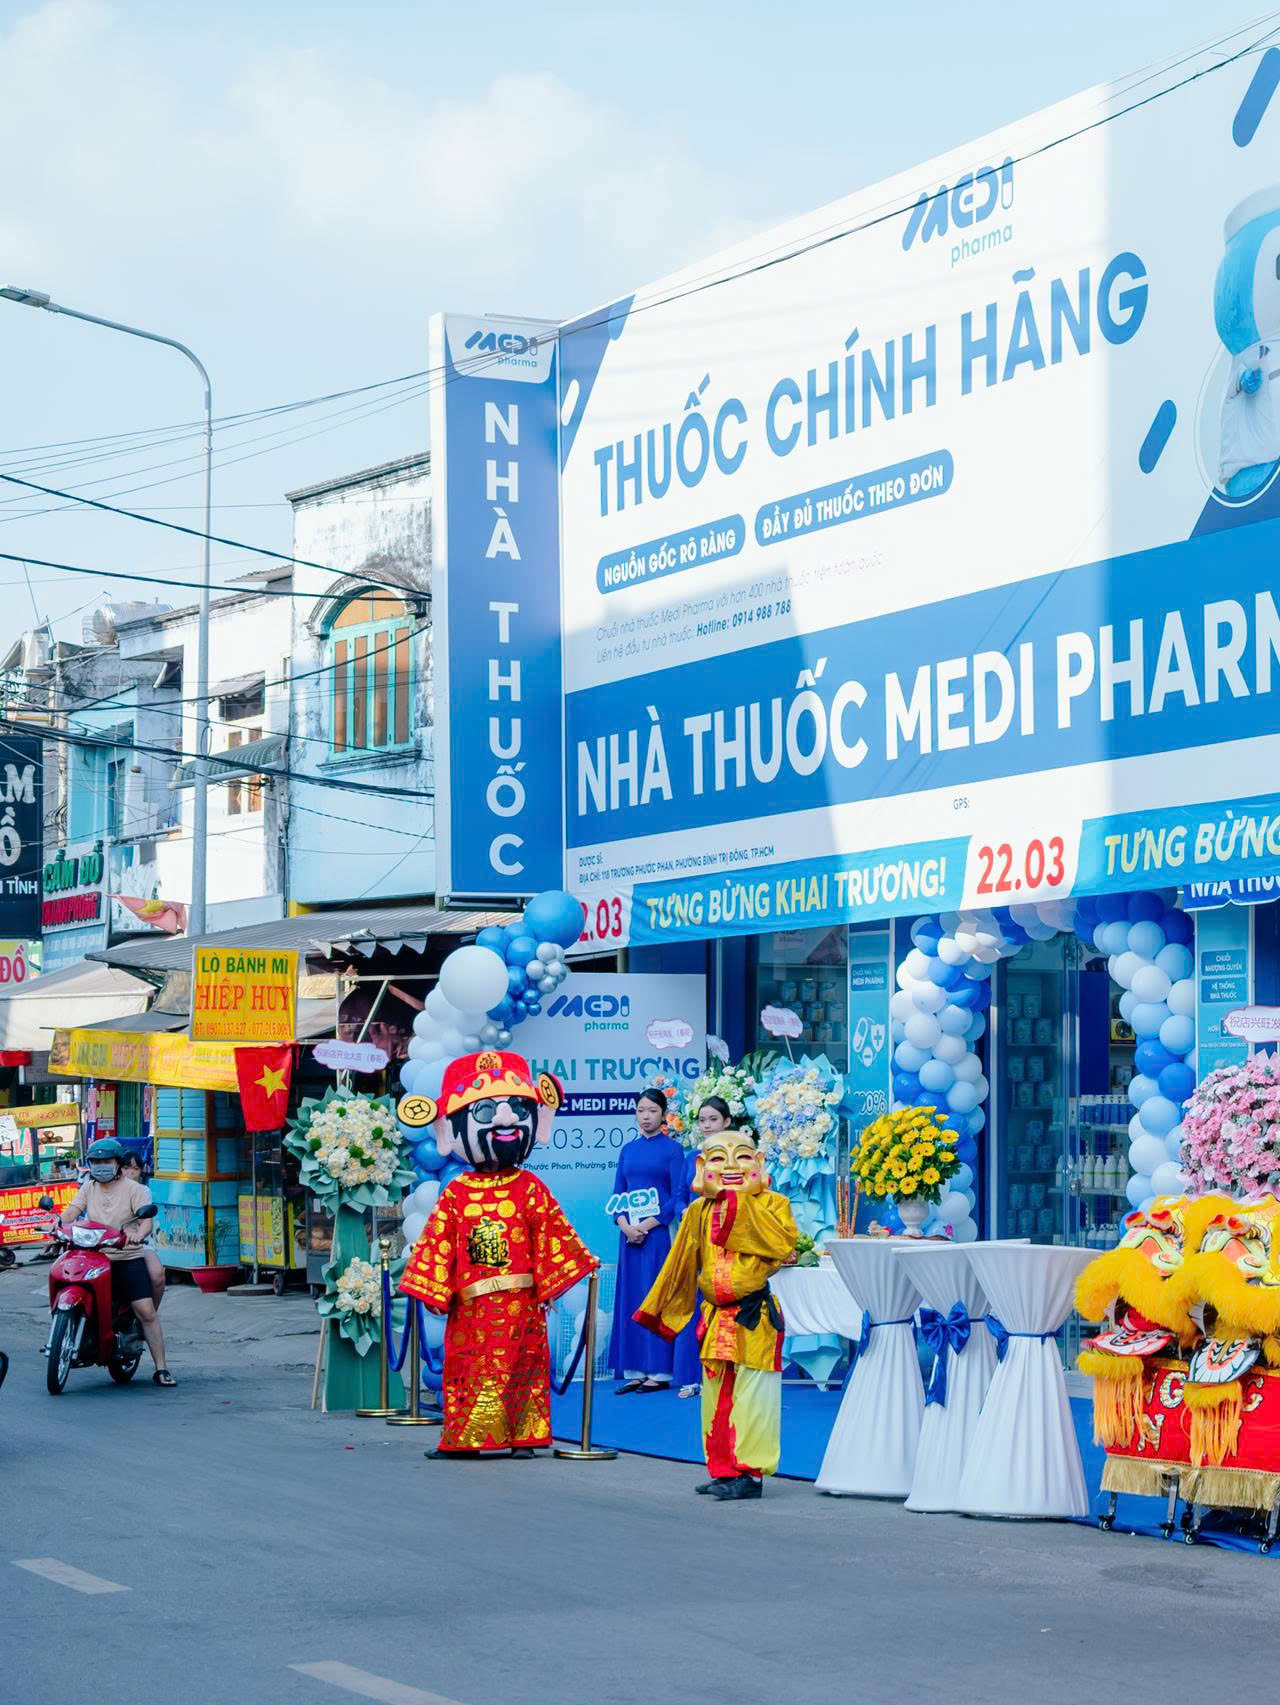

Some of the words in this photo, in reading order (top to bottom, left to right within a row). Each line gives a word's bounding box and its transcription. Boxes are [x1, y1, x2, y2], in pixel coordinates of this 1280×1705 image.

[902, 155, 1014, 252] MEDI
[950, 222, 1014, 268] pharma
[464, 330, 538, 357] MEDI
[497, 354, 538, 369] pharma
[593, 372, 748, 518] THUỐC
[765, 325, 937, 458] CHÍNH
[960, 251, 1149, 397] HÃNG
[484, 401, 521, 561] NHÀ
[762, 504, 790, 540] ĐẦY
[794, 498, 813, 530] ĐỦ
[816, 483, 865, 522] THUỐC
[868, 476, 906, 507] THEO
[910, 464, 945, 494] ĐƠN
[604, 552, 646, 587] NGUỒN
[649, 537, 677, 574] GỐC
[680, 540, 698, 566] RÕ
[701, 528, 736, 561] RÀNG
[696, 618, 730, 637] Hotline:
[732, 610, 754, 627] 0914
[756, 604, 773, 621] 988
[776, 599, 792, 616] 788
[486, 601, 525, 876] THUỐC
[577, 705, 674, 817] NHÀ
[683, 656, 869, 797] THUỐC
[885, 642, 1035, 761] MEDI
[952, 797, 970, 811] GPS:
[750, 845, 775, 860] TP.HCM
[647, 891, 704, 930] TƯNG
[708, 879, 770, 924] BỪNG
[775, 871, 830, 916] KHAI
[834, 856, 946, 909] TRƯƠNG!
[976, 834, 1066, 896] 22.03
[1104, 828, 1187, 877] TƯNG
[201, 952, 220, 973] LÒ
[226, 952, 266, 974] BÁNH
[271, 954, 289, 974] MÌ
[195, 976, 245, 1018] HIỆP
[250, 984, 291, 1011] HUY
[547, 994, 630, 1018] MEDI
[584, 1021, 630, 1032] pharma
[528, 1058, 577, 1081] HAI
[571, 1098, 607, 1112] MEDI
[609, 1097, 639, 1111] PHA
